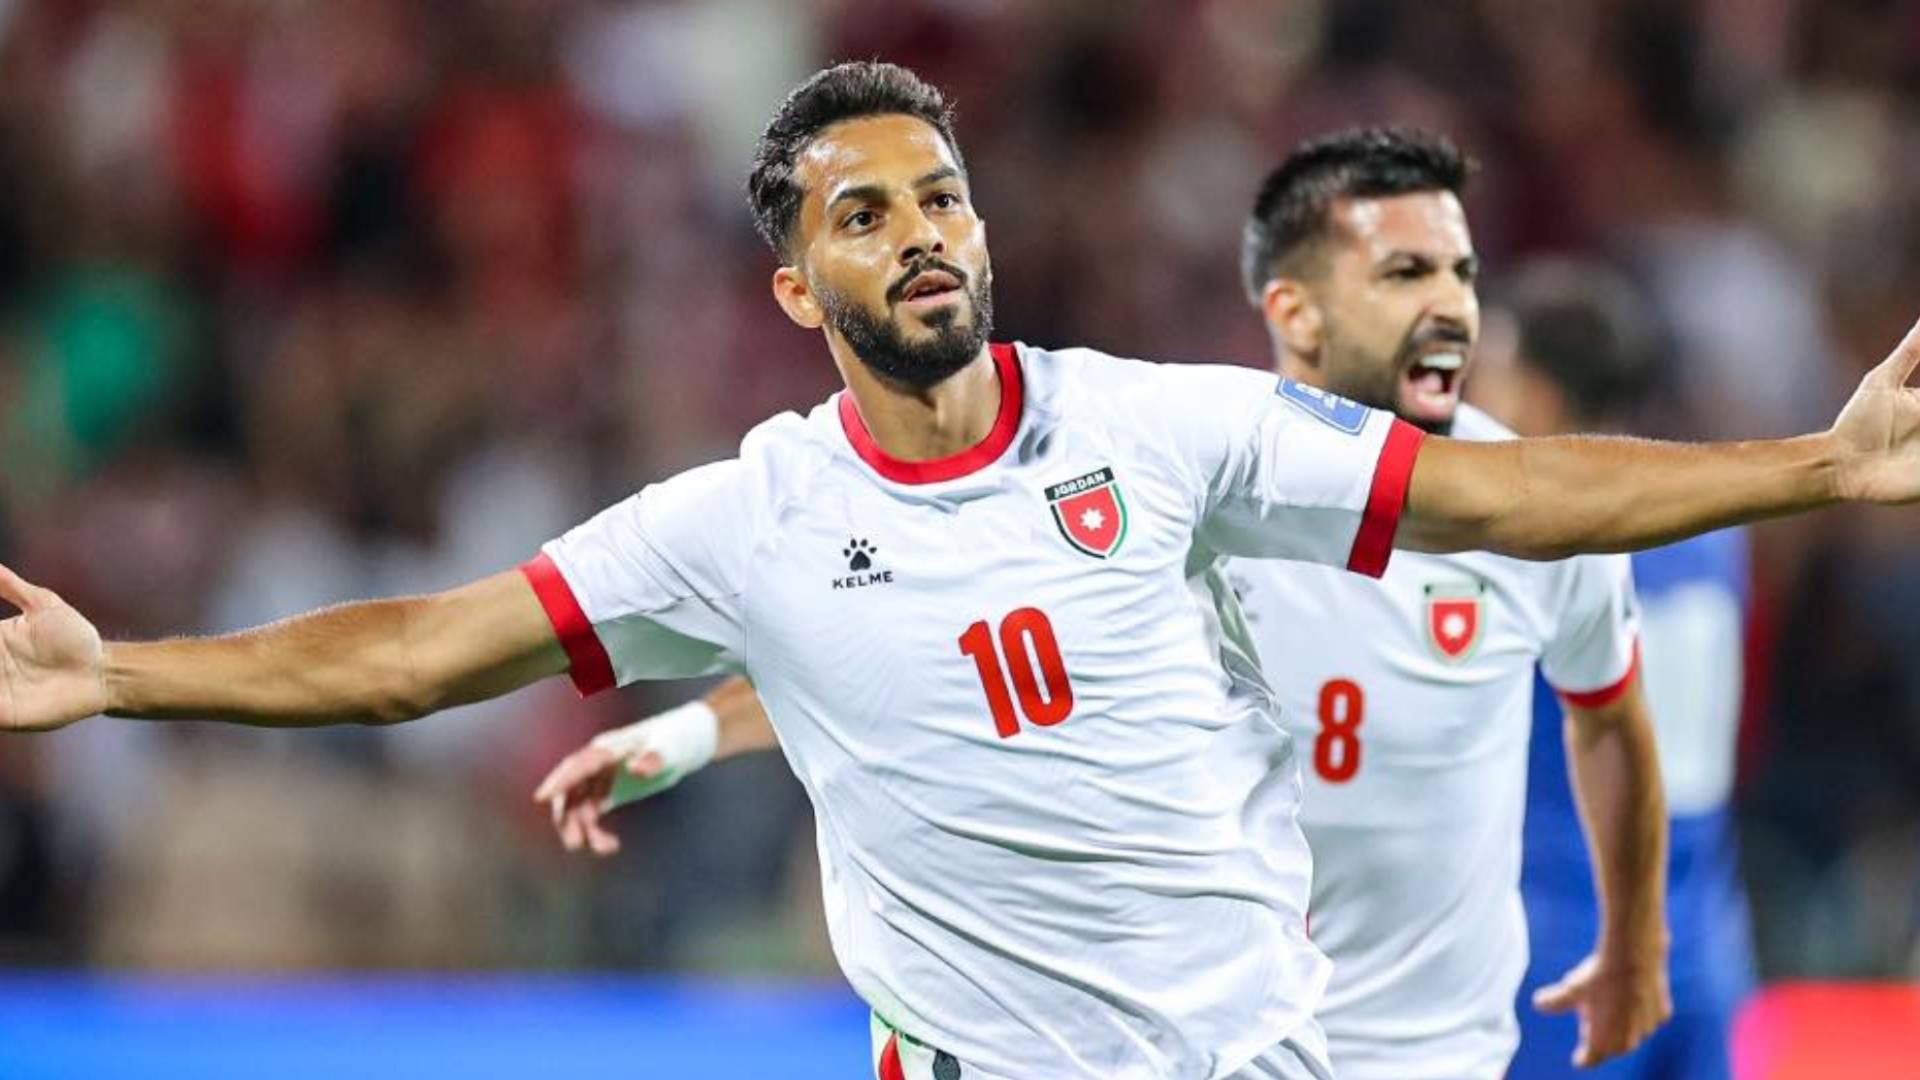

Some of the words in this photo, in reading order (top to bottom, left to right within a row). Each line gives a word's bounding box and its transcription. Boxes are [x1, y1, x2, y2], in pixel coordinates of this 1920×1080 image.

[1053, 471, 1106, 499] JORDAN
[832, 571, 893, 589] KELME
[958, 607, 1073, 739] 10
[1314, 679, 1362, 783] 8
